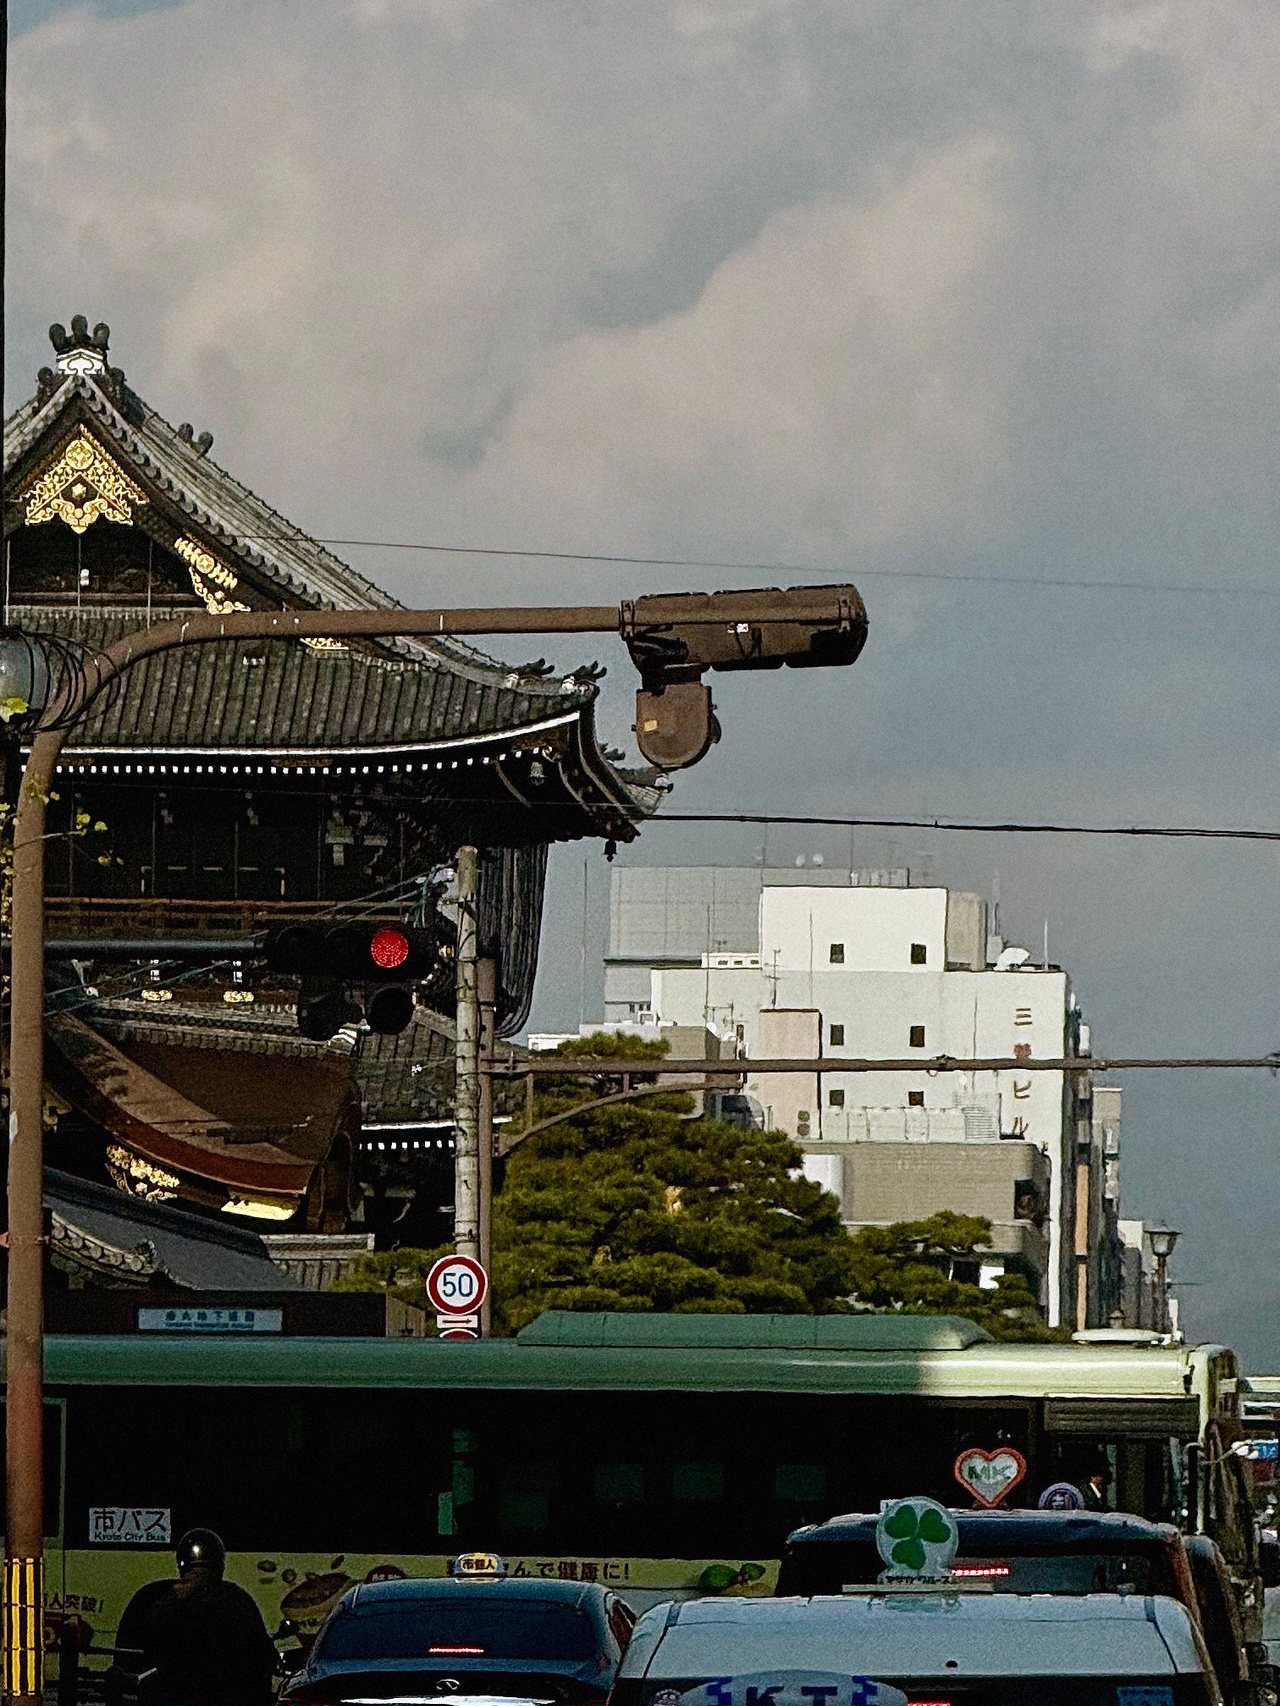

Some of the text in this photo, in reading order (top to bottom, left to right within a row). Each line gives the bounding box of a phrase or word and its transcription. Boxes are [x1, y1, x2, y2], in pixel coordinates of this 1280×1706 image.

[442, 1272, 474, 1298] 50
[93, 1508, 167, 1532] 市バス
[94, 1531, 122, 1541] Kyoto
[124, 1531, 143, 1541] City
